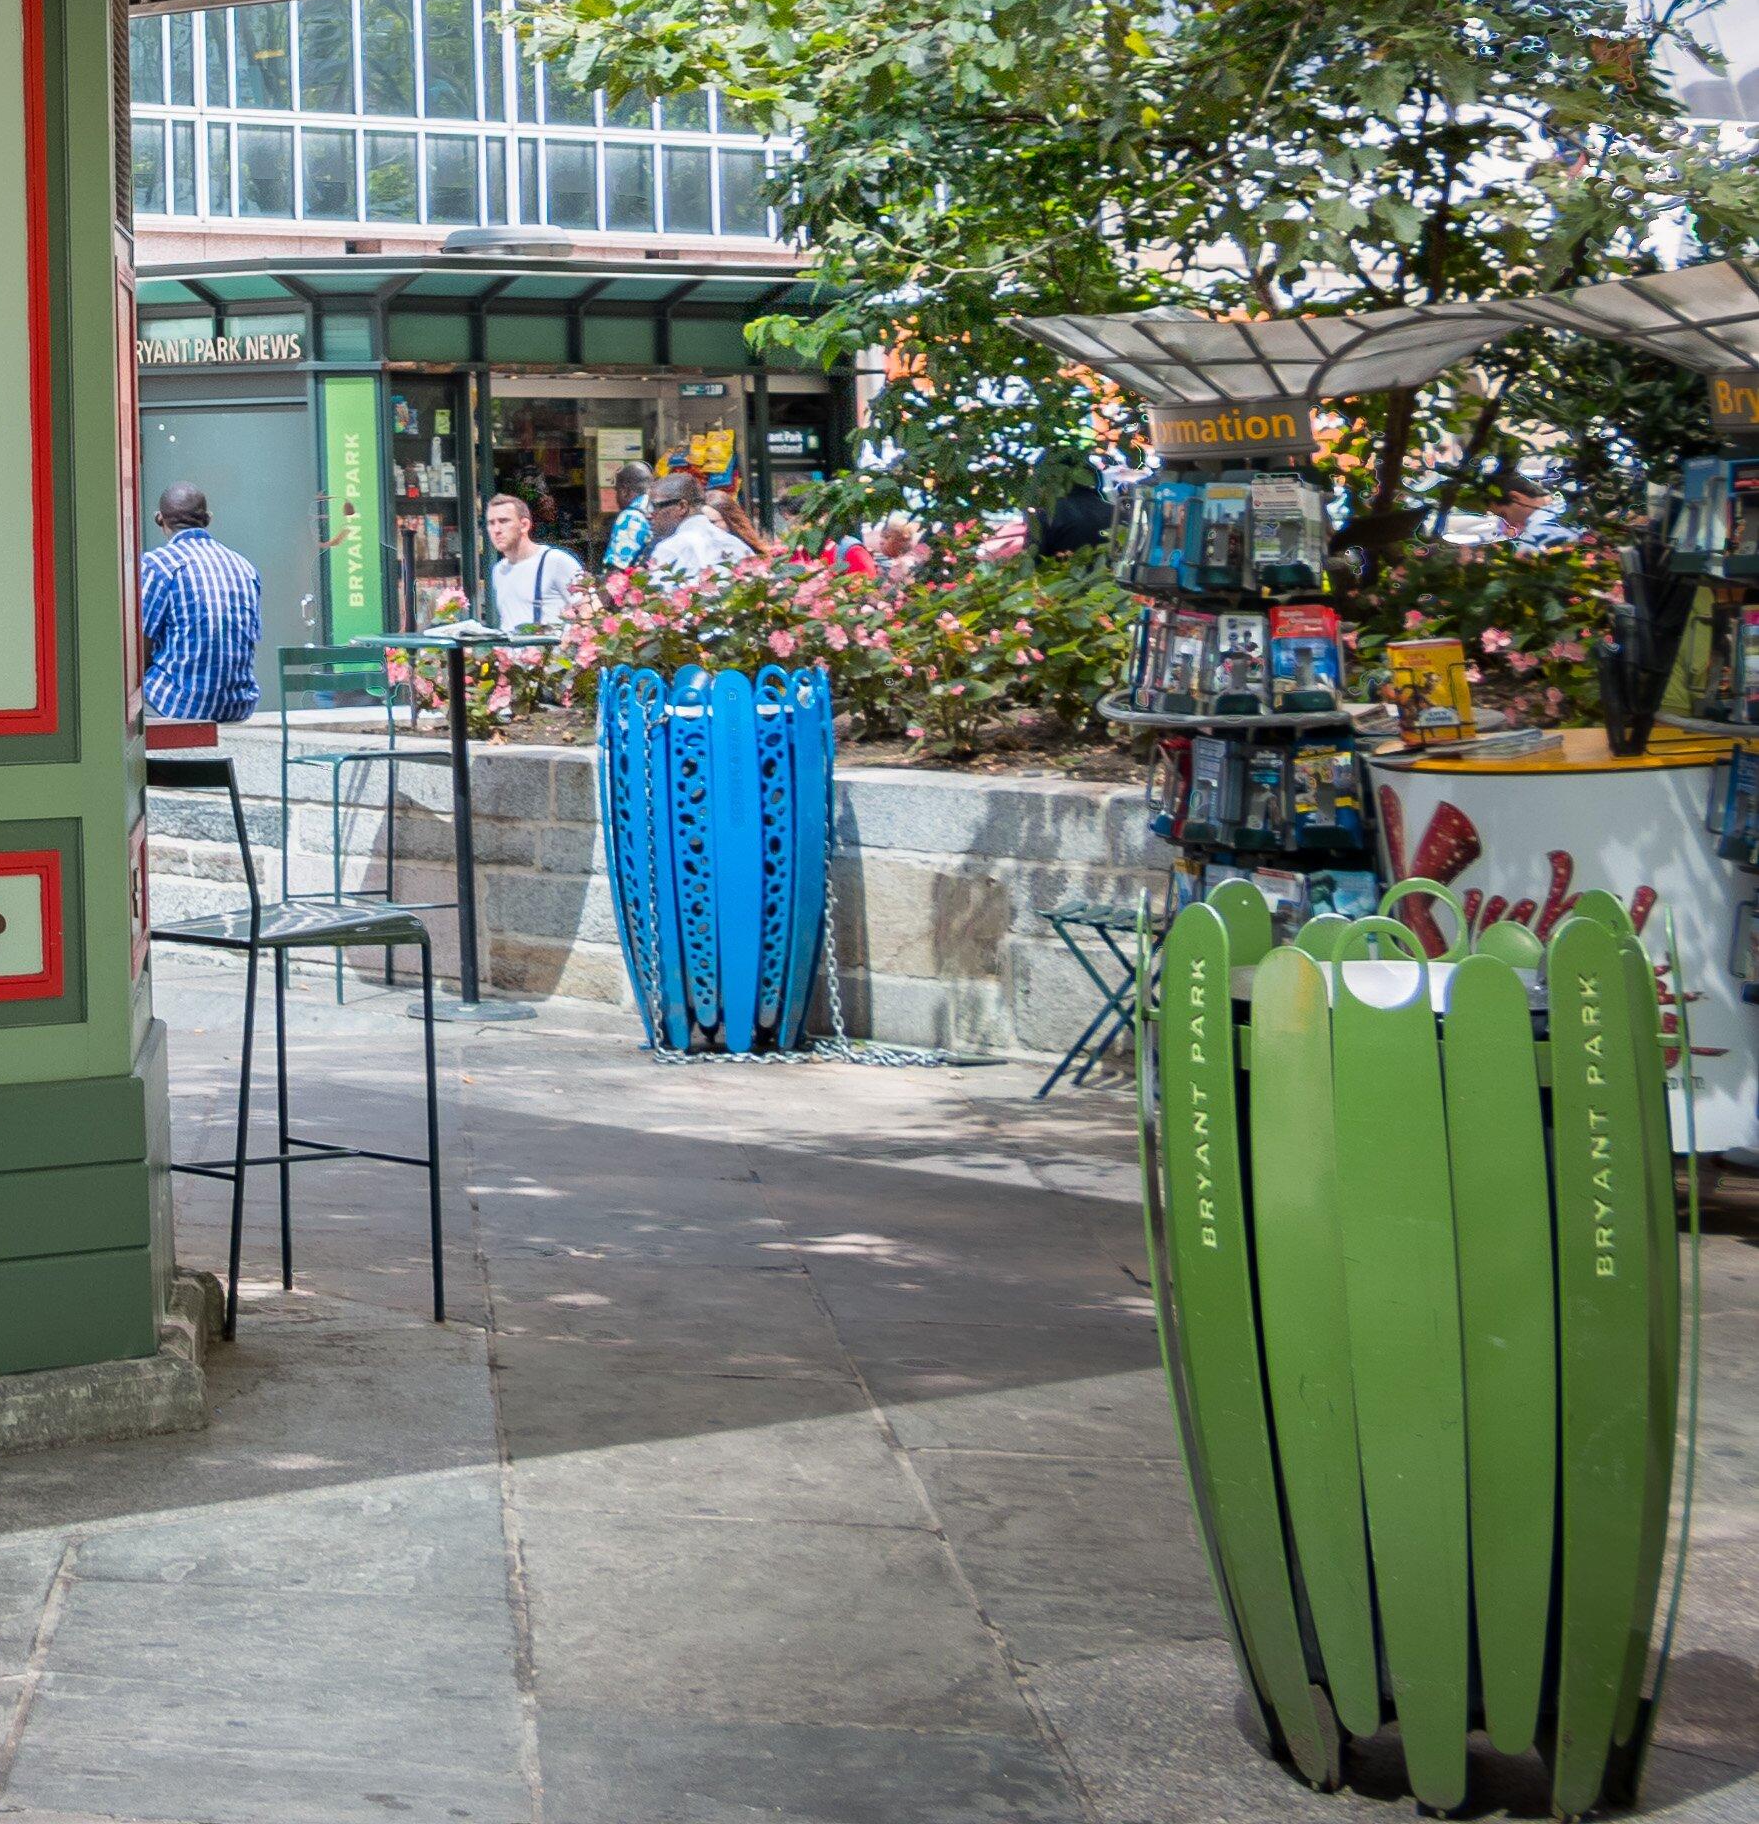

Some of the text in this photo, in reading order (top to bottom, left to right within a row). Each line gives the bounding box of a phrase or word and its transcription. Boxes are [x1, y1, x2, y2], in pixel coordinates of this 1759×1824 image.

[194, 336, 243, 363] PARK
[245, 333, 301, 361] NEWS
[344, 433, 361, 498] PARK
[1190, 958, 1218, 1249] BRYANT PARK
[1579, 973, 1616, 1276] BRYANT PARK
